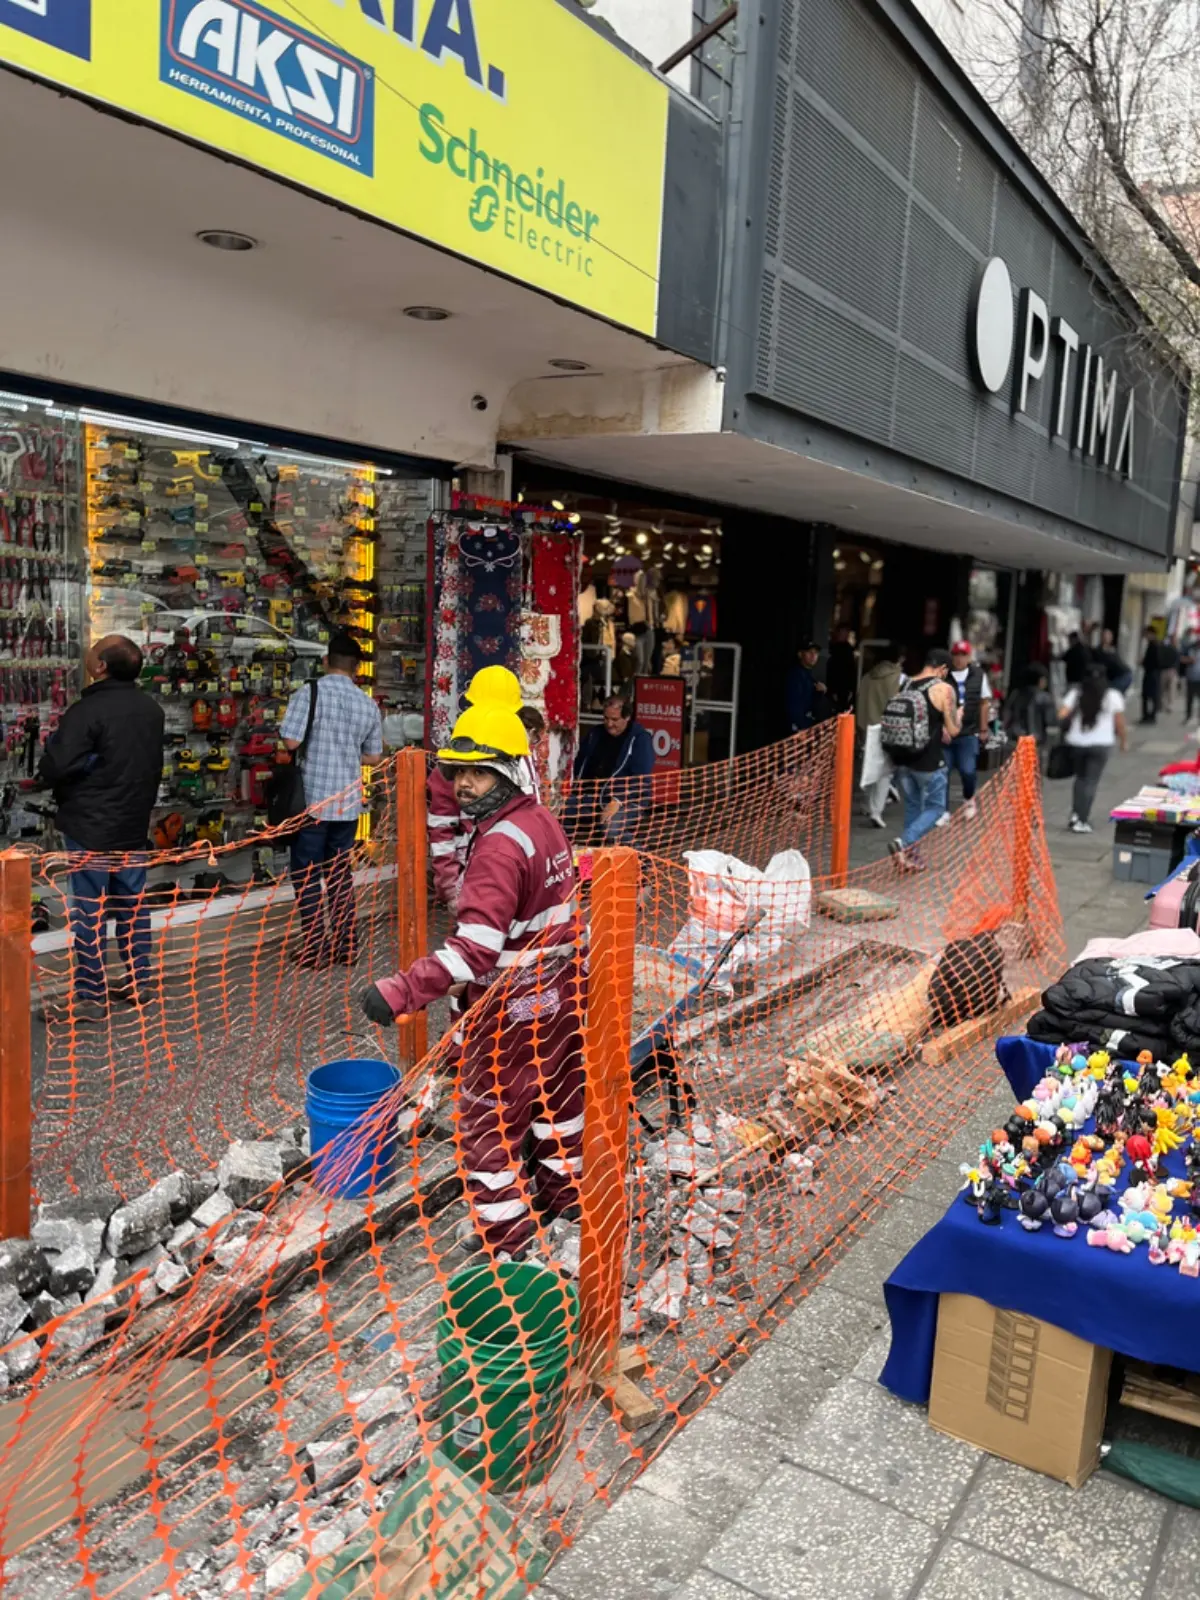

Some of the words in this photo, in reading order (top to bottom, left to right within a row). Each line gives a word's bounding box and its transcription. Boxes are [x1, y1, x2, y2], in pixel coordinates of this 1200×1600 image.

[178, 0, 357, 135] AKSI
[168, 68, 272, 123] HERRAMIENTA
[275, 117, 362, 166] PROFESIONAL
[418, 102, 600, 243] Schneider
[504, 205, 593, 277] Electric
[972, 256, 1135, 480] OPTIMA
[637, 702, 682, 717] REBAJAS
[645, 728, 681, 757] 0%
